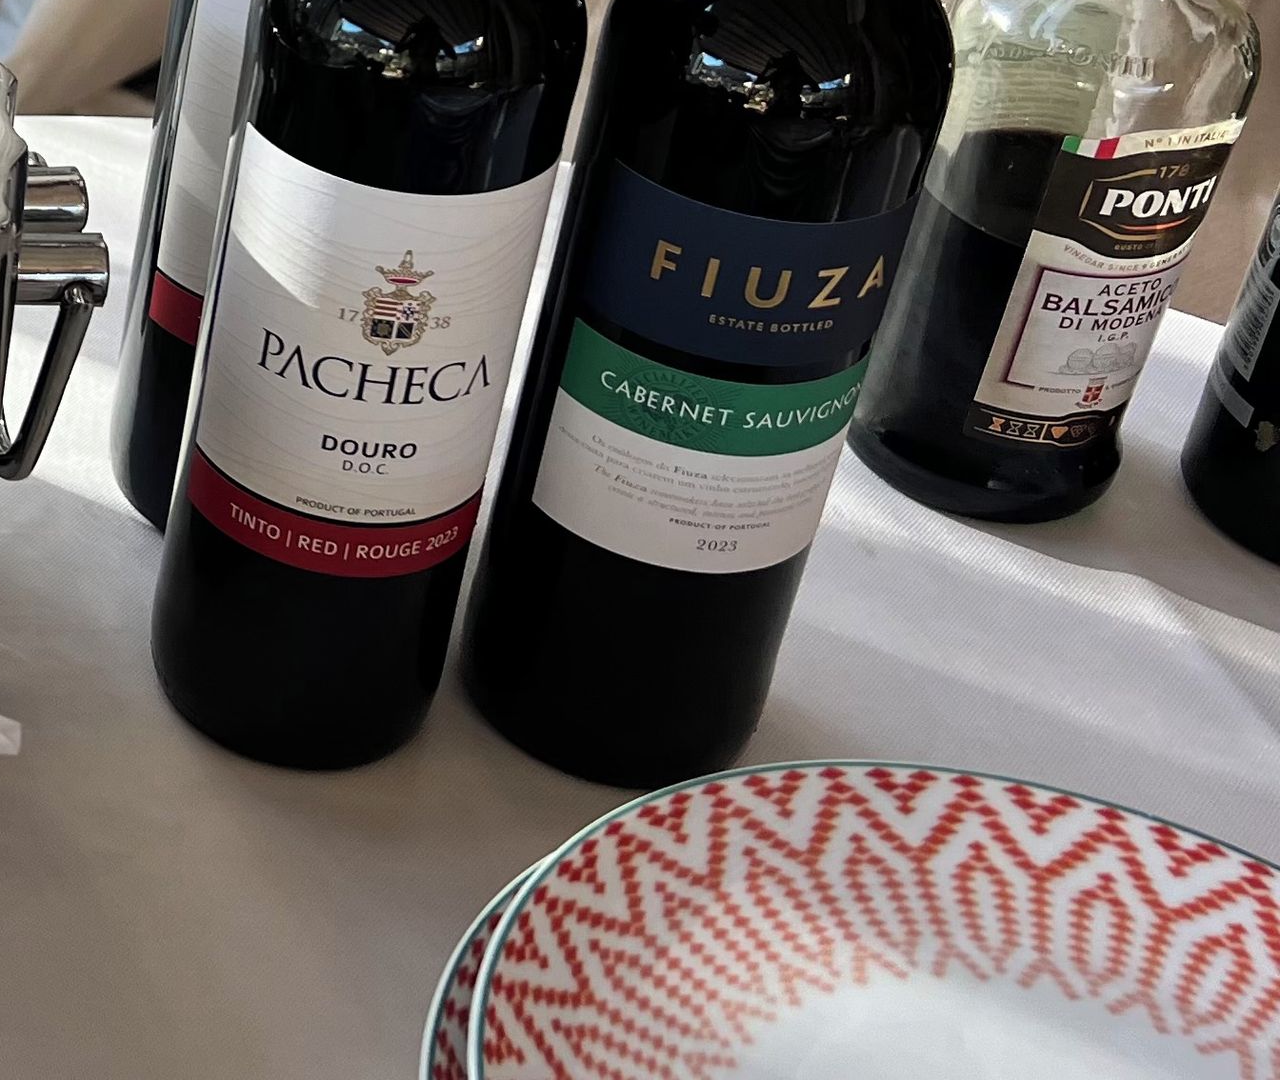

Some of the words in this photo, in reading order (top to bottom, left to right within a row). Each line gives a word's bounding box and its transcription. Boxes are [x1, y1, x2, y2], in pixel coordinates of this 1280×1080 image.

[1177, 134, 1191, 146] IN
[1098, 175, 1218, 219] PONTI
[1064, 244, 1105, 270] VINEGAR
[1107, 263, 1139, 272] SINCE
[649, 238, 886, 311] FIUZA
[1097, 277, 1163, 297] ACETO
[338, 307, 360, 322] 17
[429, 315, 452, 330] 38
[708, 313, 764, 332] ESTATE
[770, 319, 834, 334] BOTTLED
[1058, 316, 1083, 331] DI
[1090, 304, 1163, 331] MODENA
[256, 327, 491, 406] PACHECA
[600, 370, 734, 427] CABERNET
[320, 434, 418, 460] DOURO
[342, 459, 389, 475] D.O.C.
[295, 495, 345, 514] PRODUCT
[347, 507, 362, 517] OF
[363, 507, 417, 518] PORTUGAL
[228, 502, 282, 541] TINTO
[297, 534, 338, 556] RED
[355, 540, 422, 560] ROUGE
[425, 525, 459, 552] 2023
[669, 516, 711, 530] PRODUCT
[714, 523, 726, 531] OF
[729, 521, 771, 531] PORTUGAL
[696, 538, 738, 553] 2023
